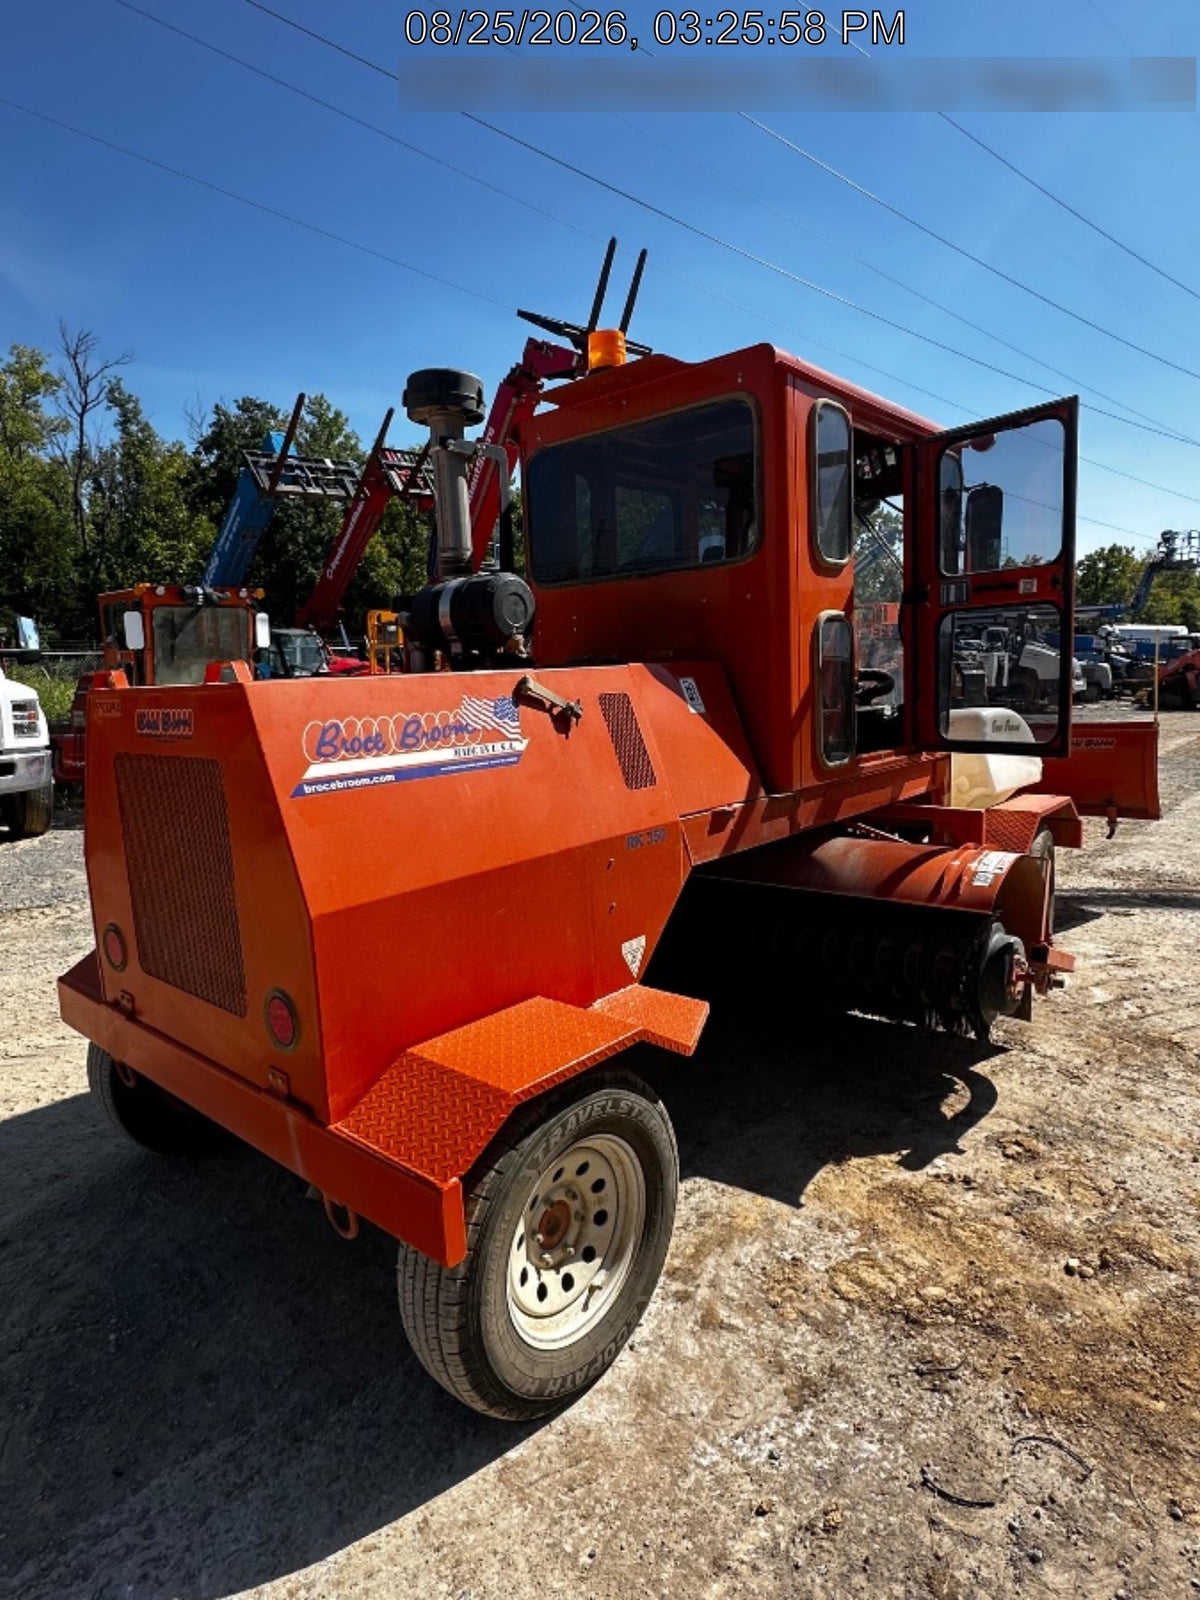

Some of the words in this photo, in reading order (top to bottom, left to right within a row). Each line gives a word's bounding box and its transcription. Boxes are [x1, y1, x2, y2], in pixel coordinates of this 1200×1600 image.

[315, 721, 387, 760] Broce
[400, 717, 476, 751] Broom
[302, 772, 397, 795] brocebroom.com
